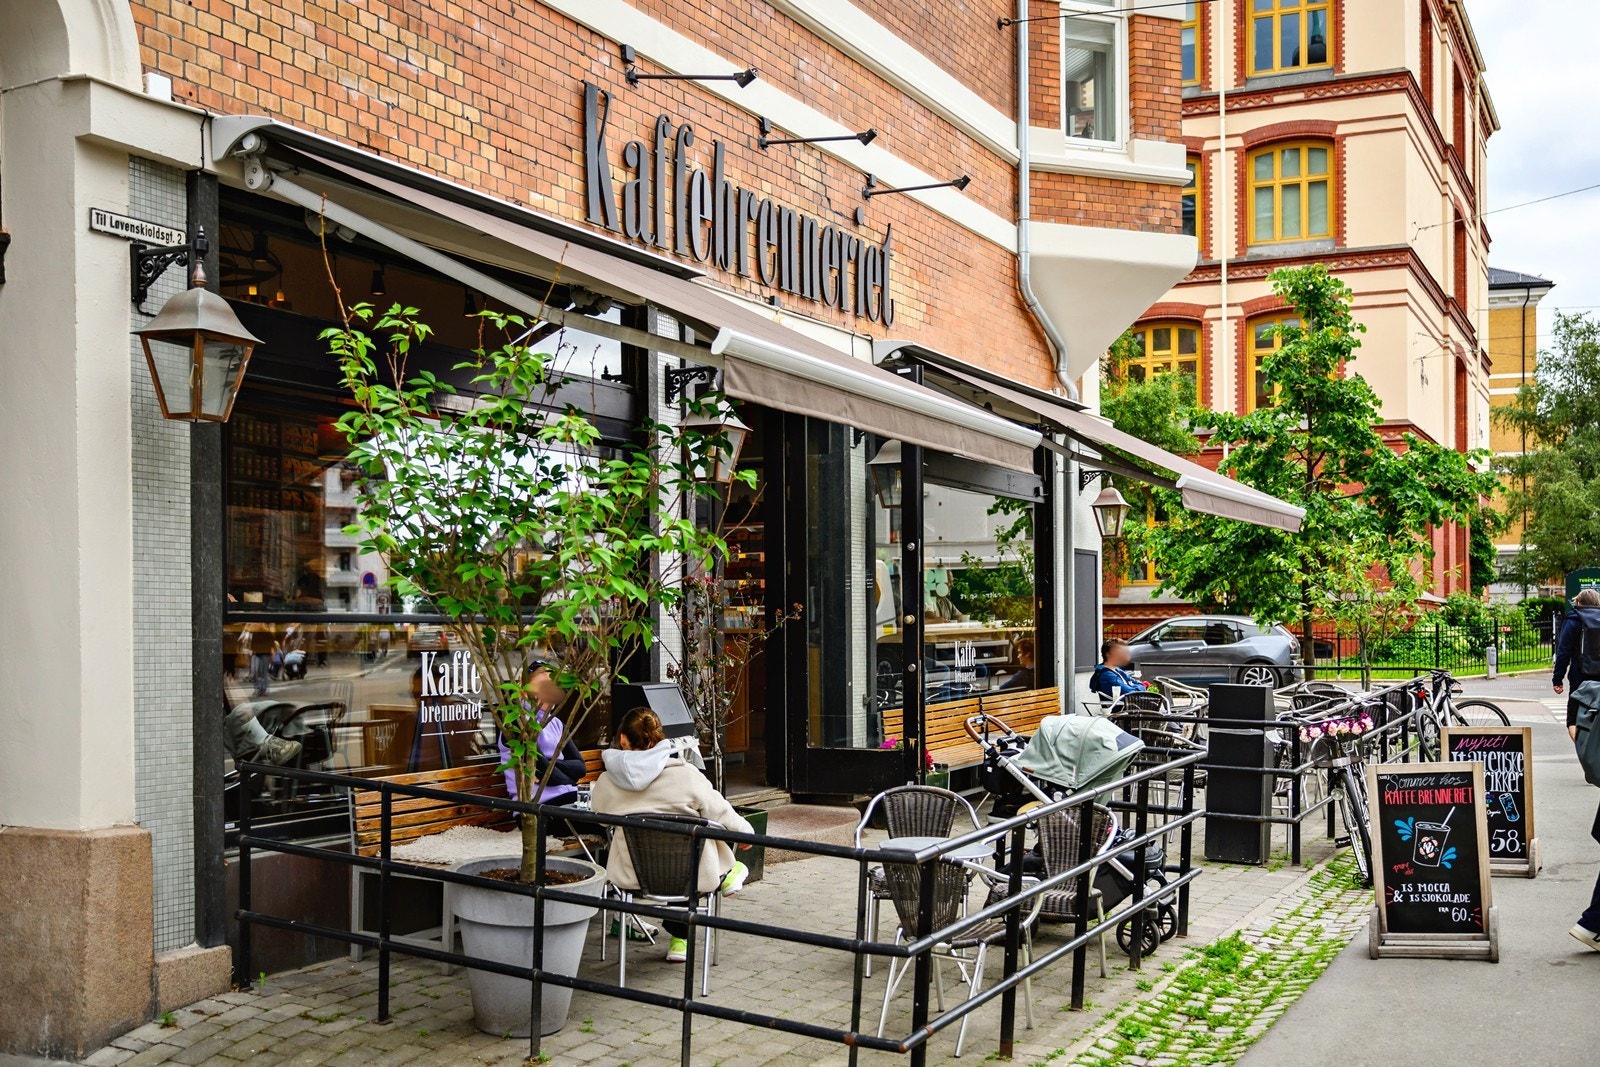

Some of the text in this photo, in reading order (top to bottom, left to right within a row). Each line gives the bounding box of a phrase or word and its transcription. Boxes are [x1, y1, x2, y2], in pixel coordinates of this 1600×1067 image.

[581, 80, 895, 328] Kaffebrenneriet
[95, 212, 182, 244] Til Løvenskioldsgt. 2
[954, 640, 976, 667] Kaffe
[420, 650, 482, 697] Kaffe
[420, 699, 482, 723] brenneriet
[1385, 774, 1435, 793] Sommer
[1439, 773, 1468, 786] hos
[1484, 771, 1524, 793] rikker
[1417, 883, 1450, 893] MOCCA
